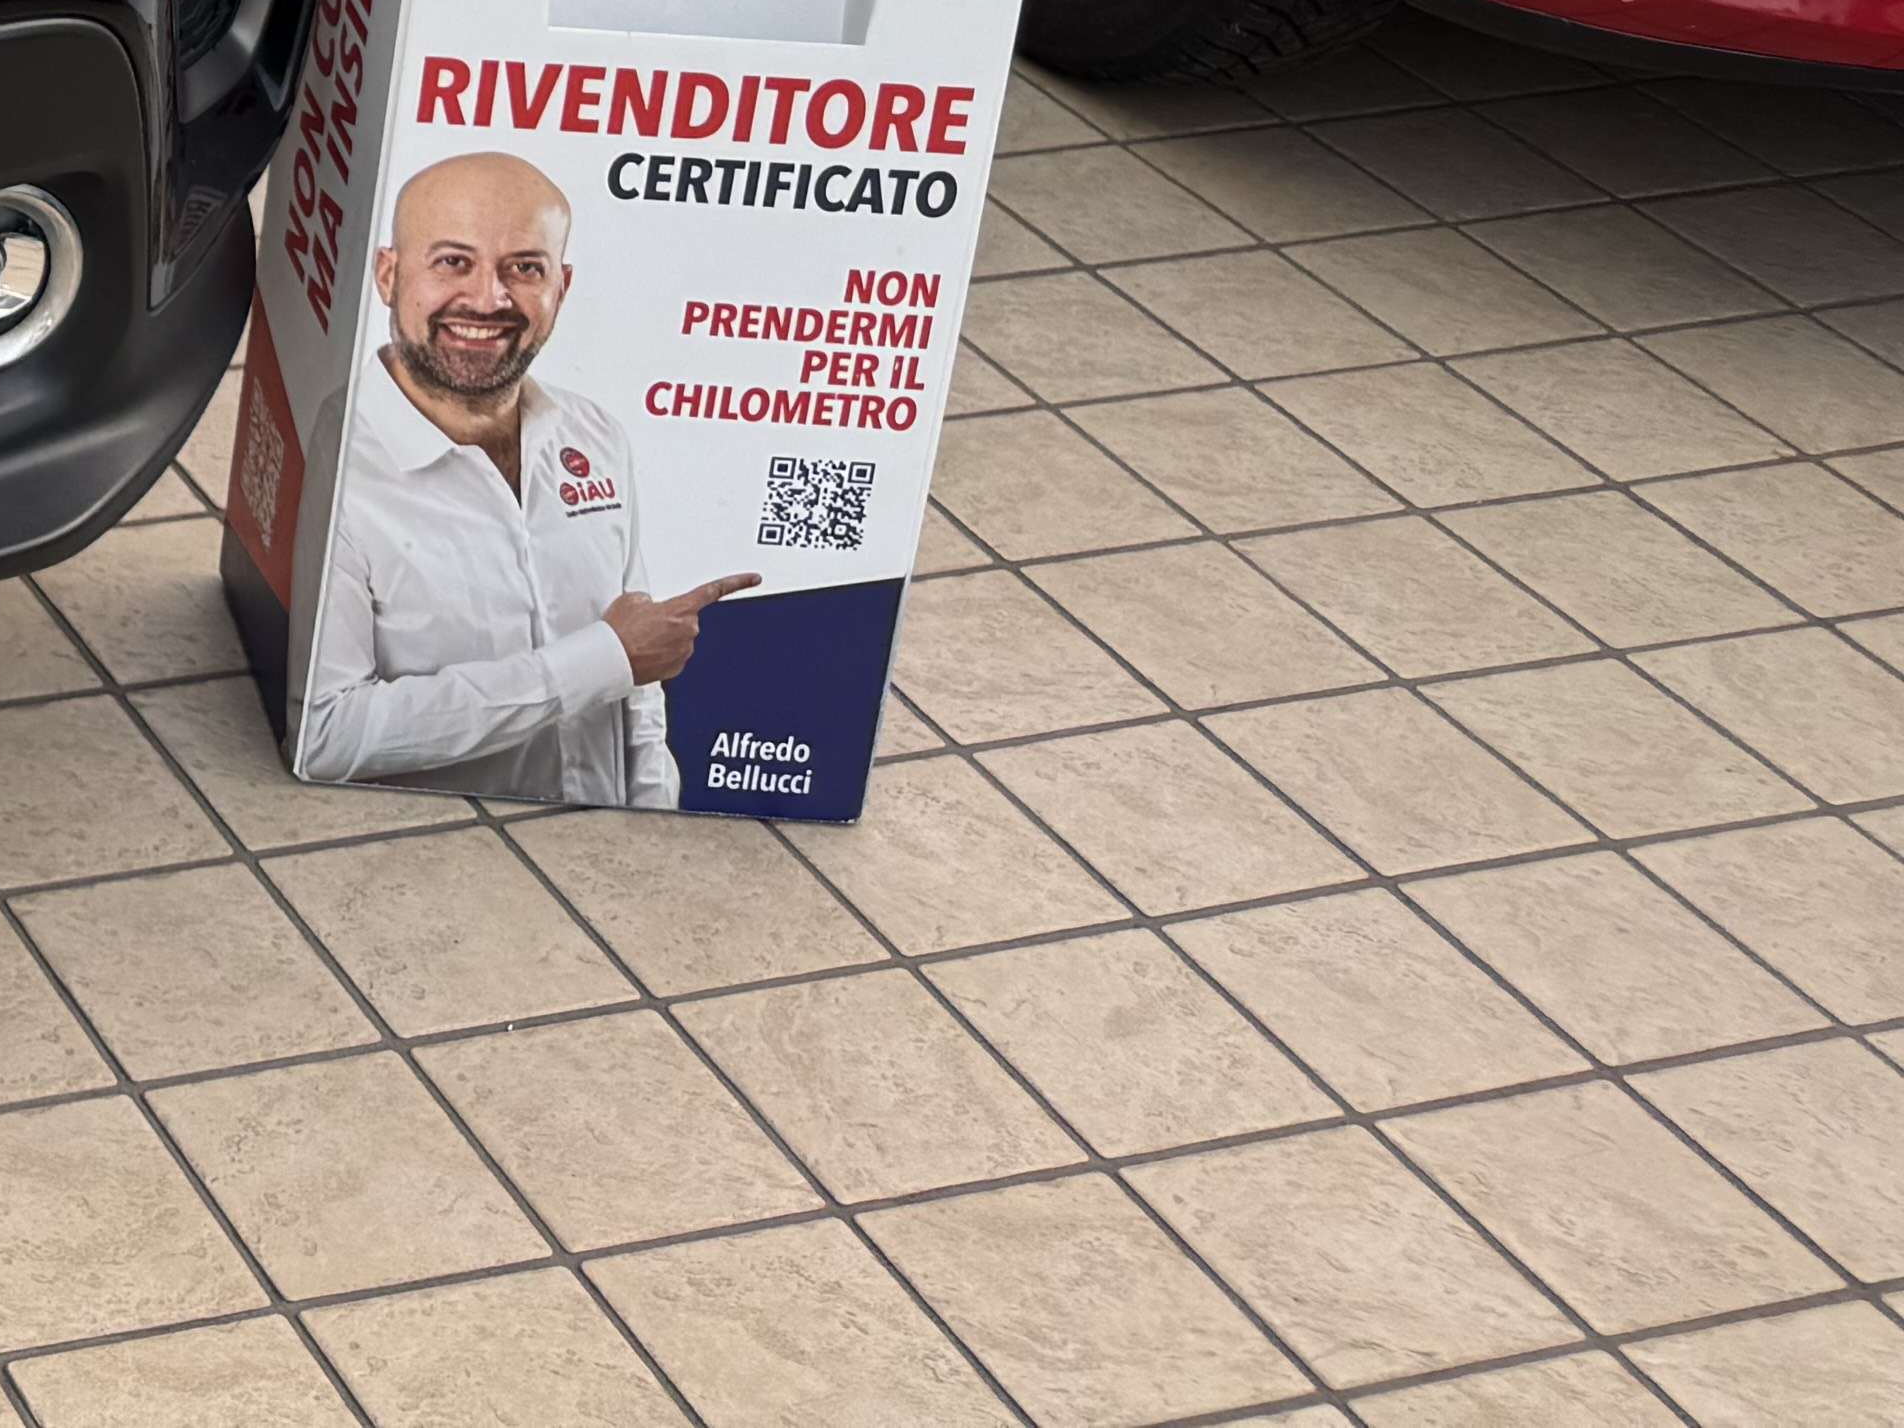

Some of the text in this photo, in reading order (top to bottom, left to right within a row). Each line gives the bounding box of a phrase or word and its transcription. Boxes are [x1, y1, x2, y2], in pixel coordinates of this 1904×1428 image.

[415, 56, 976, 156] RIVENDITORE
[285, 85, 325, 283] NON
[606, 152, 959, 219] CERTIFICATO
[305, 186, 344, 336] MA
[843, 268, 941, 310] NON
[682, 301, 934, 350] PRENDERMI
[800, 348, 926, 391] PER IL
[644, 380, 919, 432] CHILOMETRO
[710, 731, 812, 765] Alfredo
[706, 763, 813, 796] Bellucci
